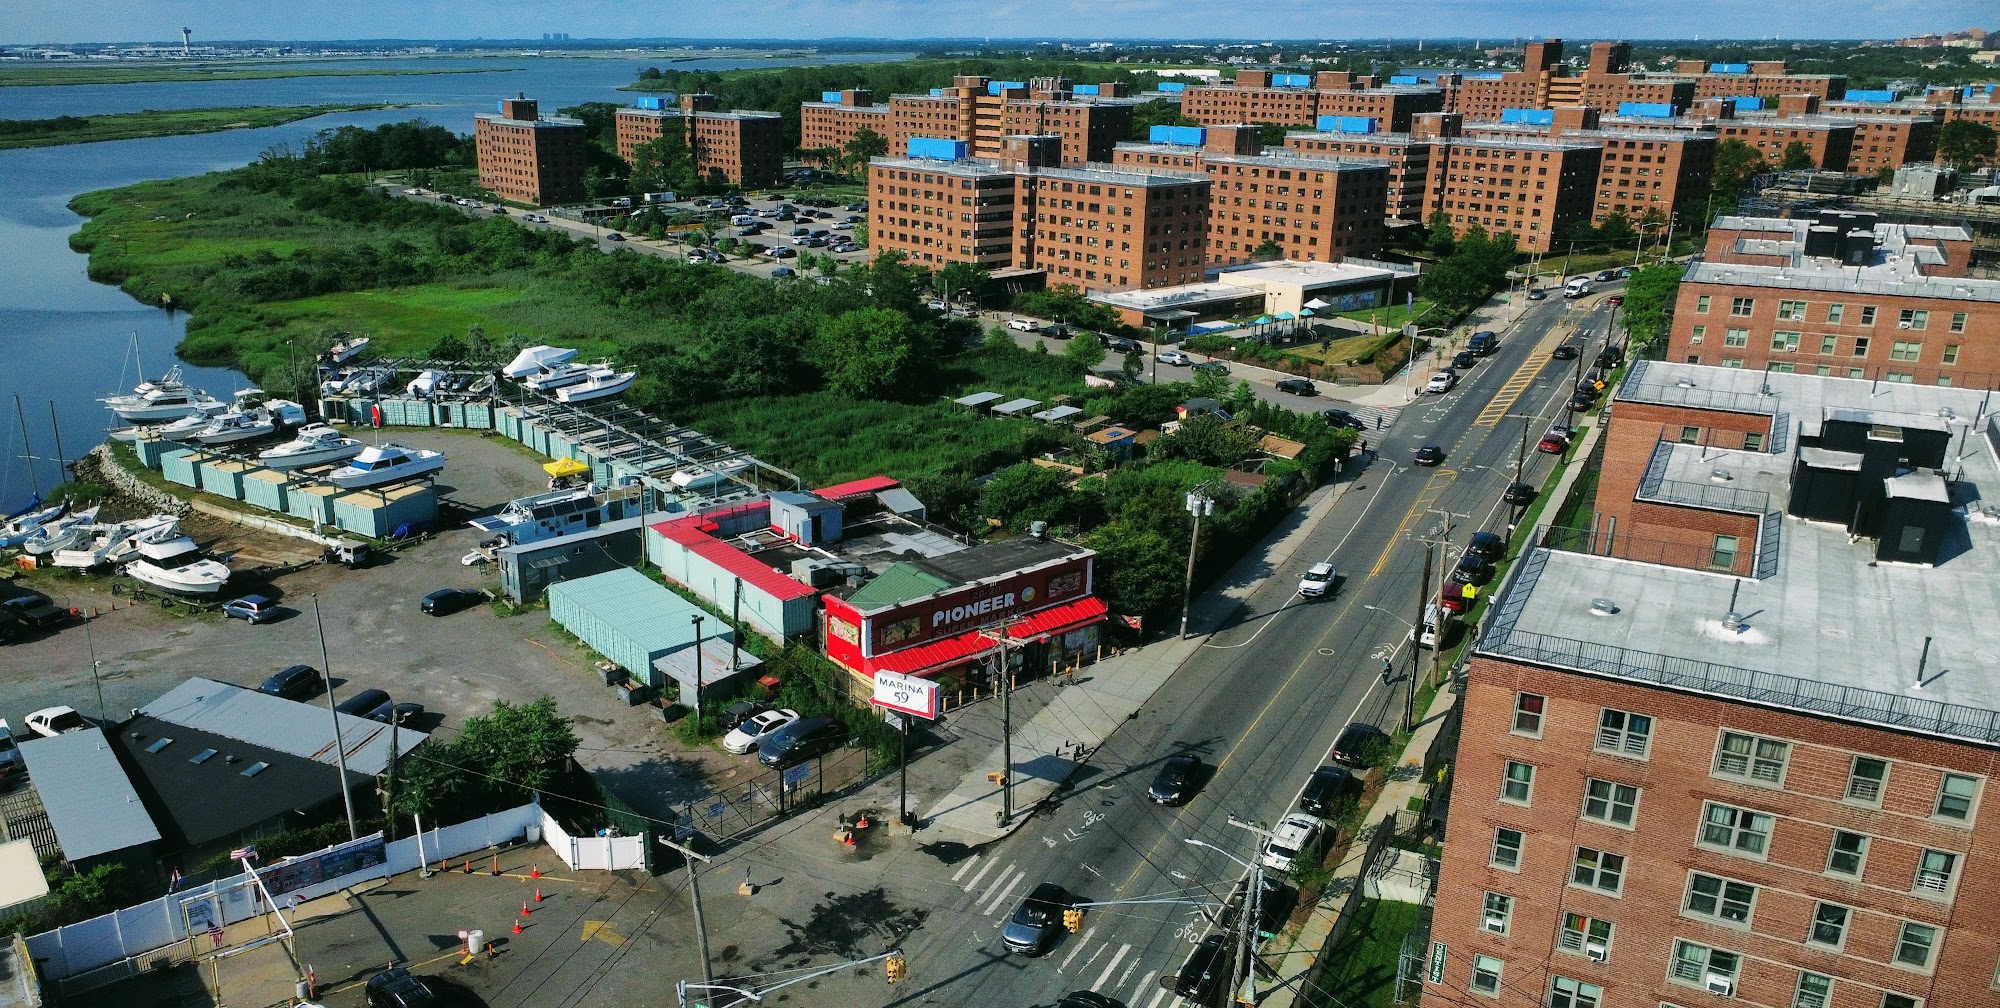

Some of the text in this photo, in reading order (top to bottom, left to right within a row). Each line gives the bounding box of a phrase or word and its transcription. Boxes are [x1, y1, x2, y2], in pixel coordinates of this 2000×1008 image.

[932, 592, 1014, 627] PIONEER
[935, 622, 974, 636] SUPER
[879, 677, 923, 695] MARINA
[894, 691, 909, 704] 59
[1432, 944, 1443, 983] DENTIST
